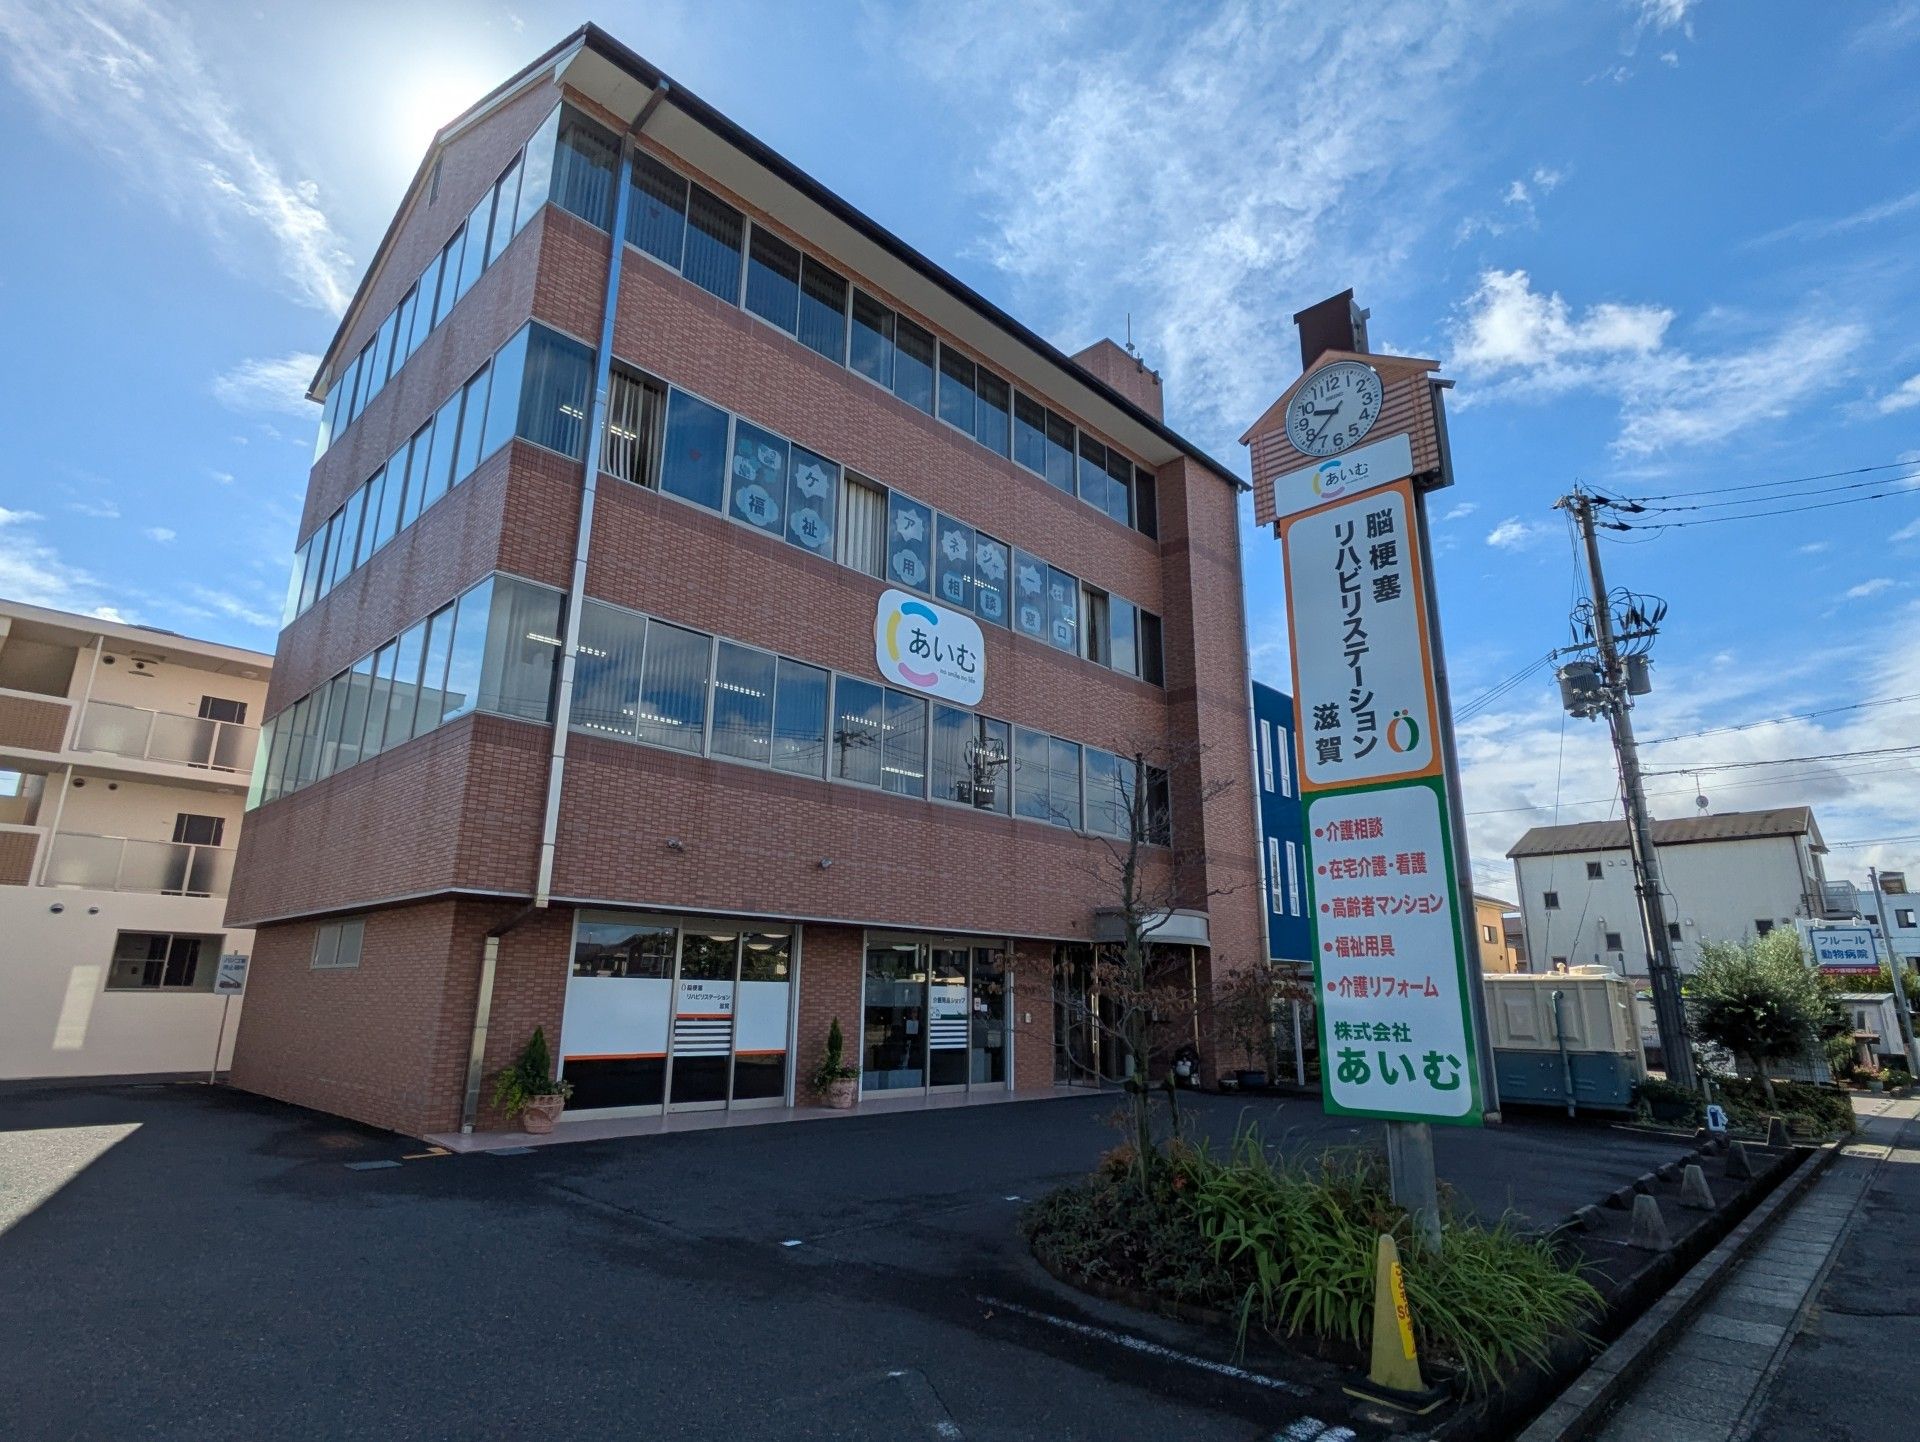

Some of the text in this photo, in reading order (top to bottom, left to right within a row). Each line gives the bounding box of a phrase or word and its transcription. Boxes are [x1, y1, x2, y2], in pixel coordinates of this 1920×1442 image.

[1326, 377, 1340, 392] 12
[1346, 375, 1350, 387] 1
[1356, 380, 1366, 393] 2
[1311, 387, 1324, 400] 11
[1362, 393, 1373, 406] 3
[1298, 402, 1314, 416] 10
[1359, 408, 1370, 420] 4
[1299, 418, 1309, 431] 9
[1348, 423, 1359, 437] 5
[1306, 429, 1318, 442] 8
[1319, 435, 1328, 448] 7
[1333, 433, 1343, 446] 6
[1326, 463, 1368, 486] あいむ
[1365, 508, 1402, 603] 脳梗塞
[1334, 520, 1378, 759] リハビリステーション
[909, 628, 976, 673] あいむ
[1313, 702, 1343, 765] 滋賀
[1325, 817, 1384, 842] 介護相談
[1328, 851, 1427, 880] 在宅介護・看護
[1332, 893, 1444, 918] 高齢者マンション
[1335, 935, 1395, 958] 福祉用具
[1818, 936, 1866, 945] フルール
[1821, 949, 1868, 959] 動物病院
[1338, 975, 1440, 998] 介護リフォーム
[1333, 1021, 1412, 1042] 株式会社
[1336, 1046, 1462, 1091] あいむ
